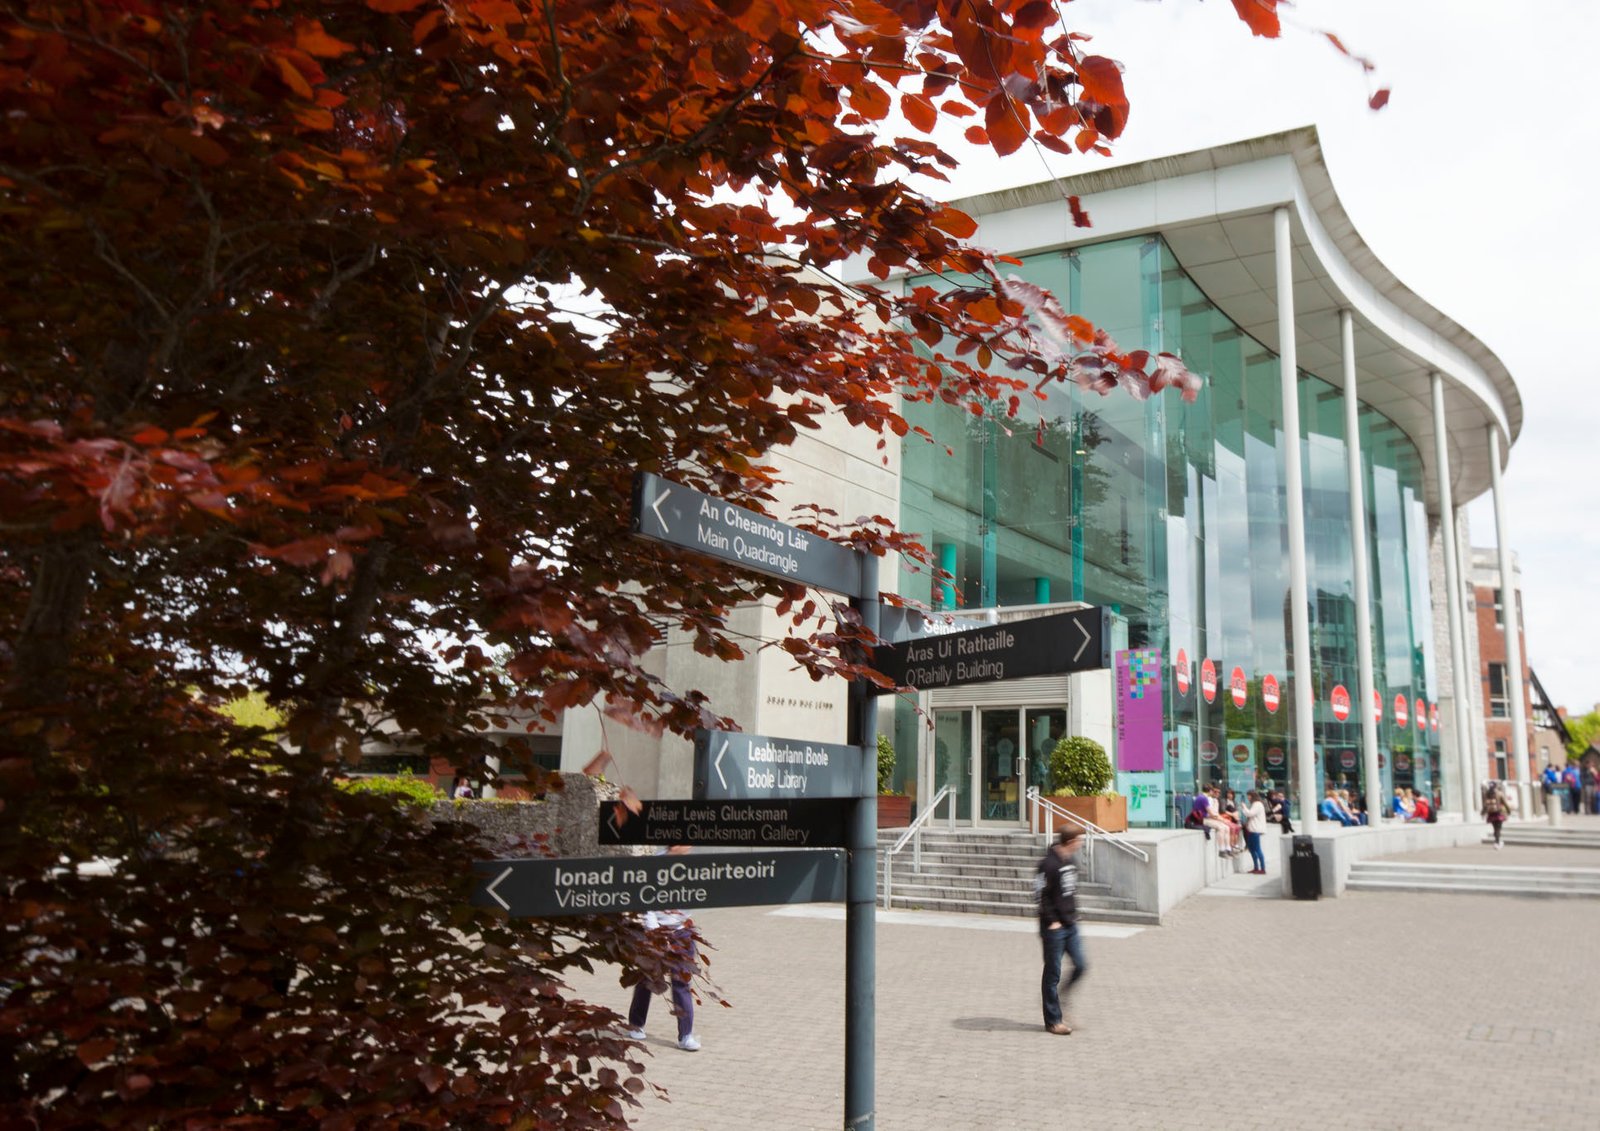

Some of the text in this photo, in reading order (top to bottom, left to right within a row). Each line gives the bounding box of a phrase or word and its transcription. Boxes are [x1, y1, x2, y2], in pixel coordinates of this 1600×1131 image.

[699, 498, 719, 521] An
[724, 506, 784, 547] Chearnóg
[697, 522, 798, 574] Main Quadrangle
[957, 630, 1015, 656] Rathaille
[905, 659, 1004, 688] O'Rahilly Building
[748, 739, 829, 766] Leabharlann Boole
[747, 766, 808, 793] Boole Library
[683, 805, 716, 821] Lewis
[721, 804, 788, 822] Glucksman
[646, 823, 810, 843] Lewis Glucksman Gallery
[554, 860, 777, 887] Ionad na gCuairteoirí
[554, 885, 708, 909] Visitors Centre
